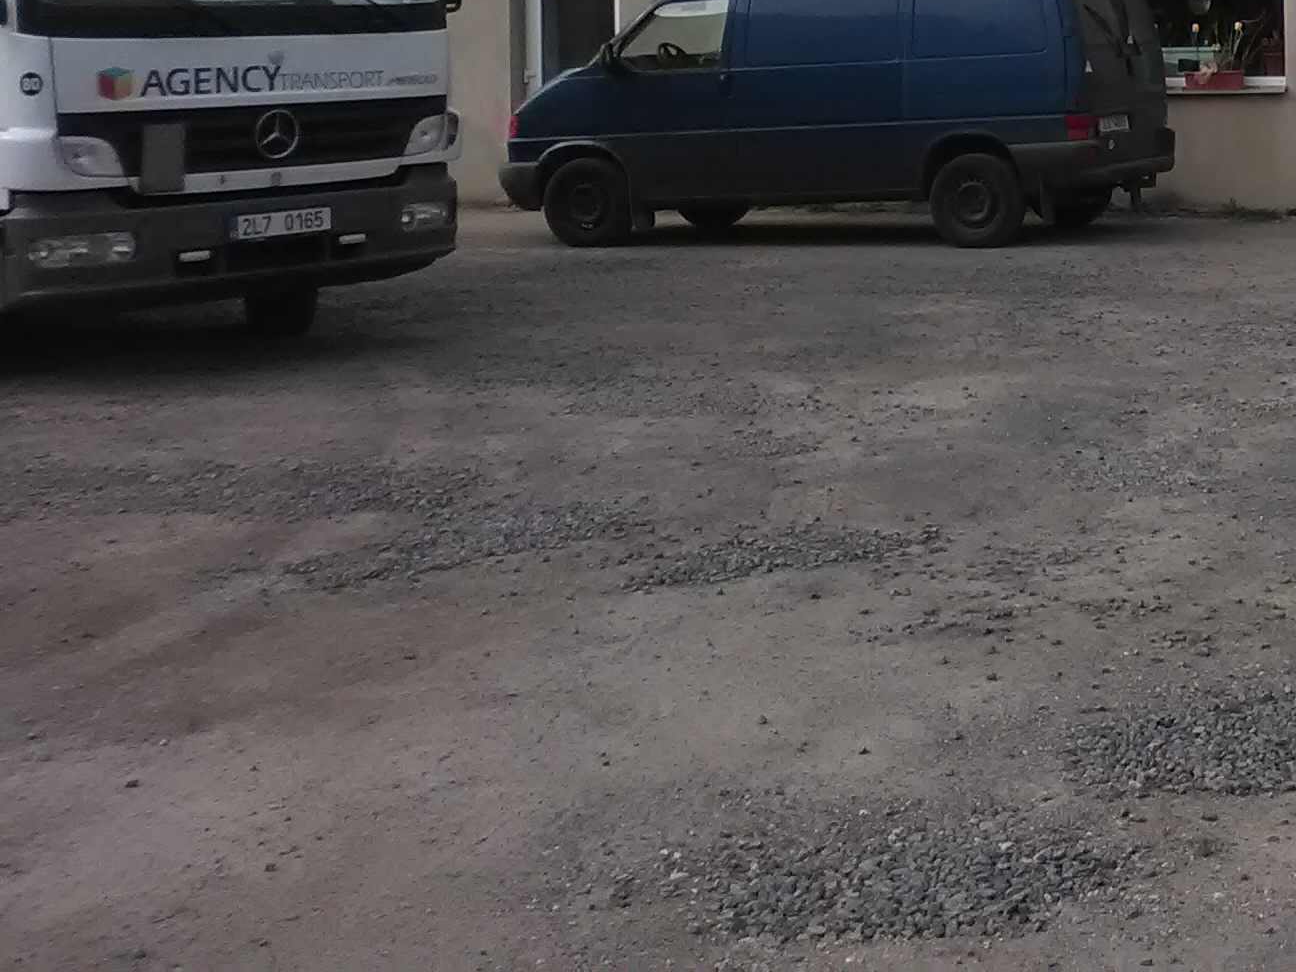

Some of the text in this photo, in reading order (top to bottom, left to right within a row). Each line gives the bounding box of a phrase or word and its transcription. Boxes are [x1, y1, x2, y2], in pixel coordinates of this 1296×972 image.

[140, 64, 281, 97] AGENCY
[279, 69, 385, 91] TRANSPORT
[242, 210, 324, 236] 2L7 0165
